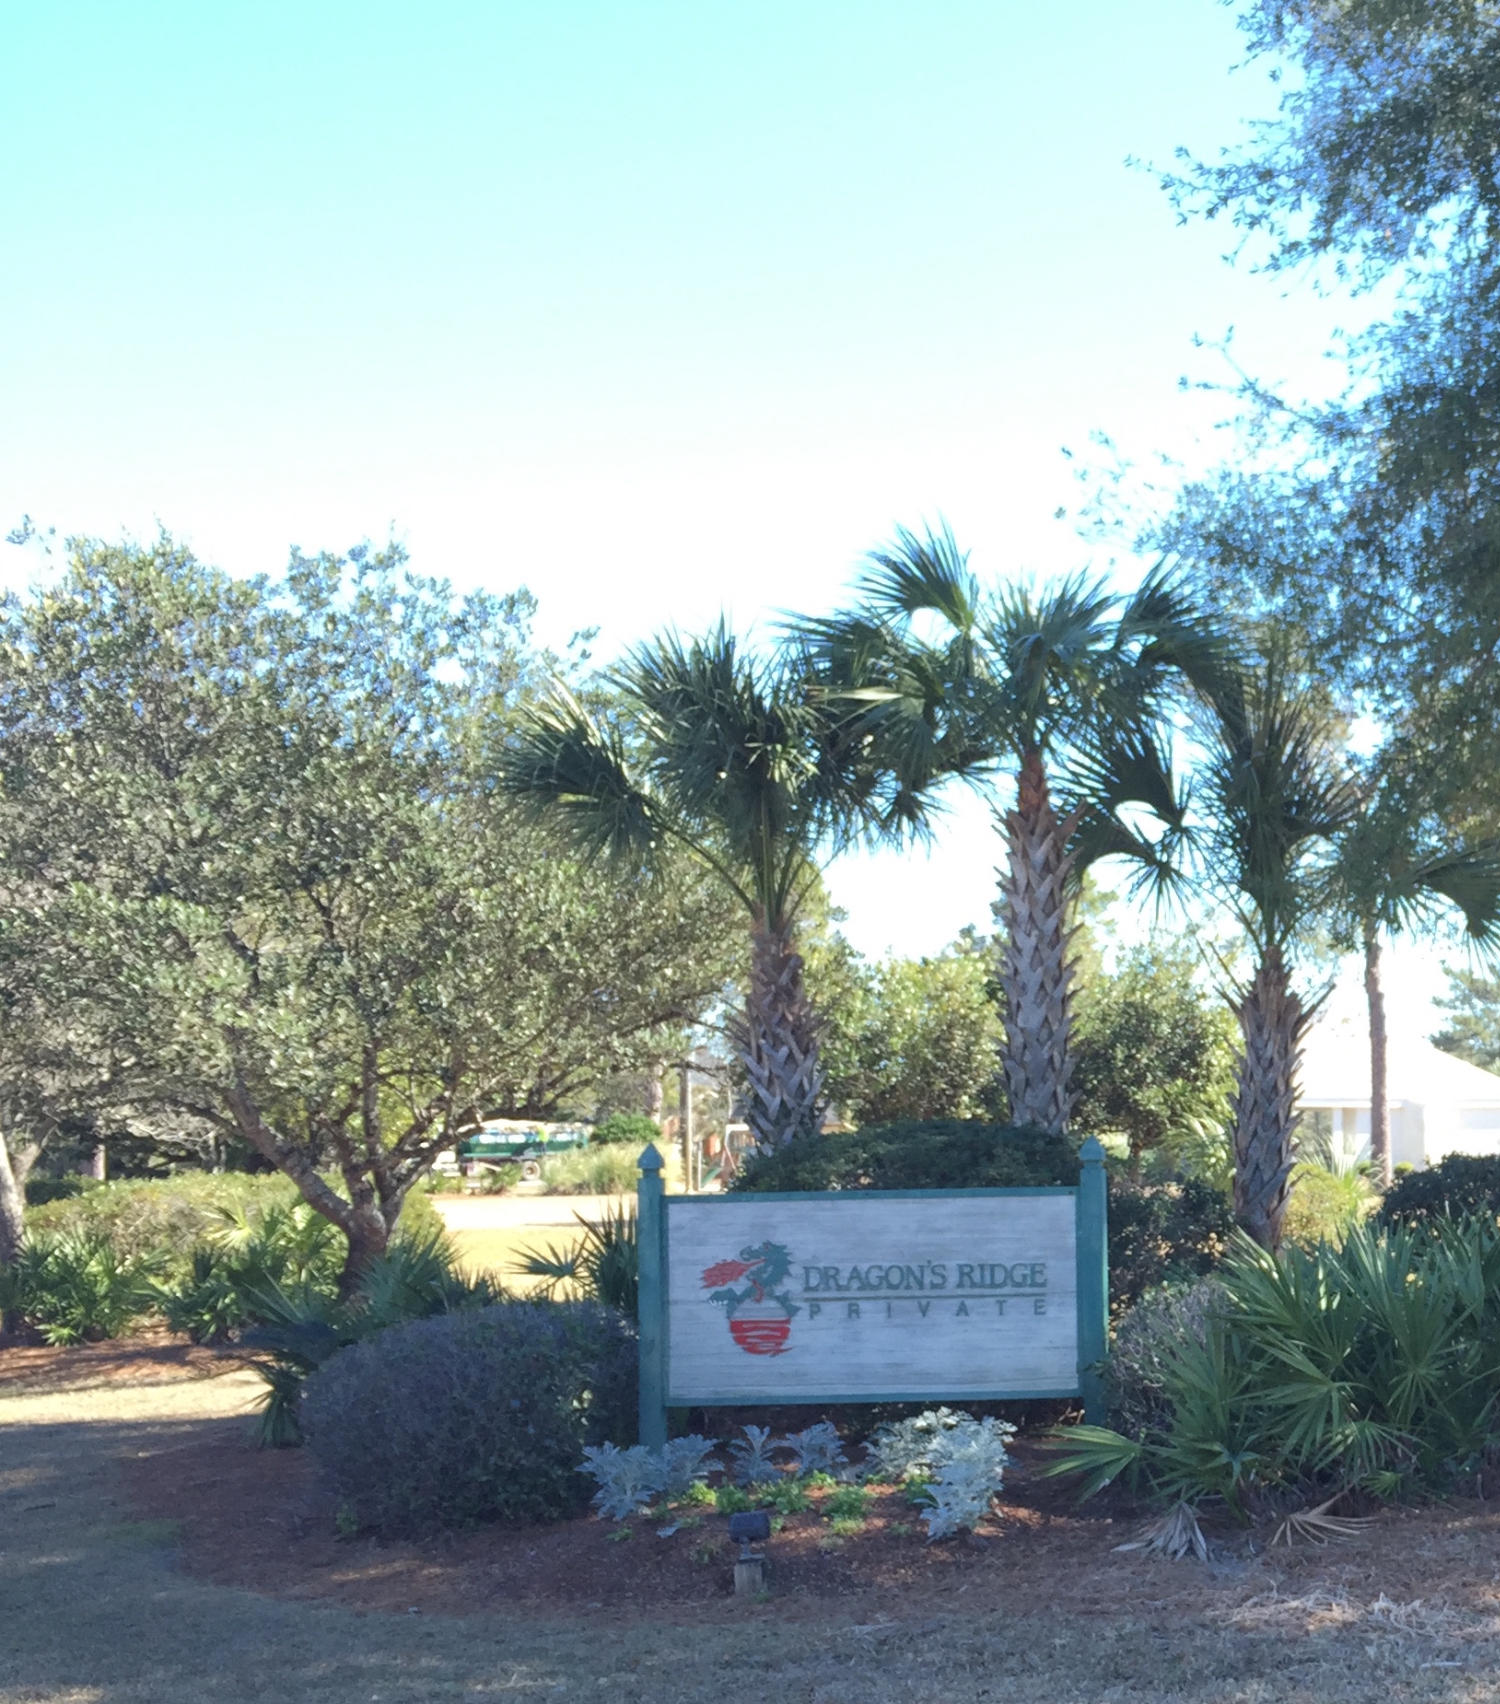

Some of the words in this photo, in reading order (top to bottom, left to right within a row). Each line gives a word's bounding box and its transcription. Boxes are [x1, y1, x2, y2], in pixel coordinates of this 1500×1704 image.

[802, 1260, 947, 1292] DRAGON'S
[956, 1263, 1047, 1289] RIDGE
[809, 1299, 1047, 1319] PRIVATE
